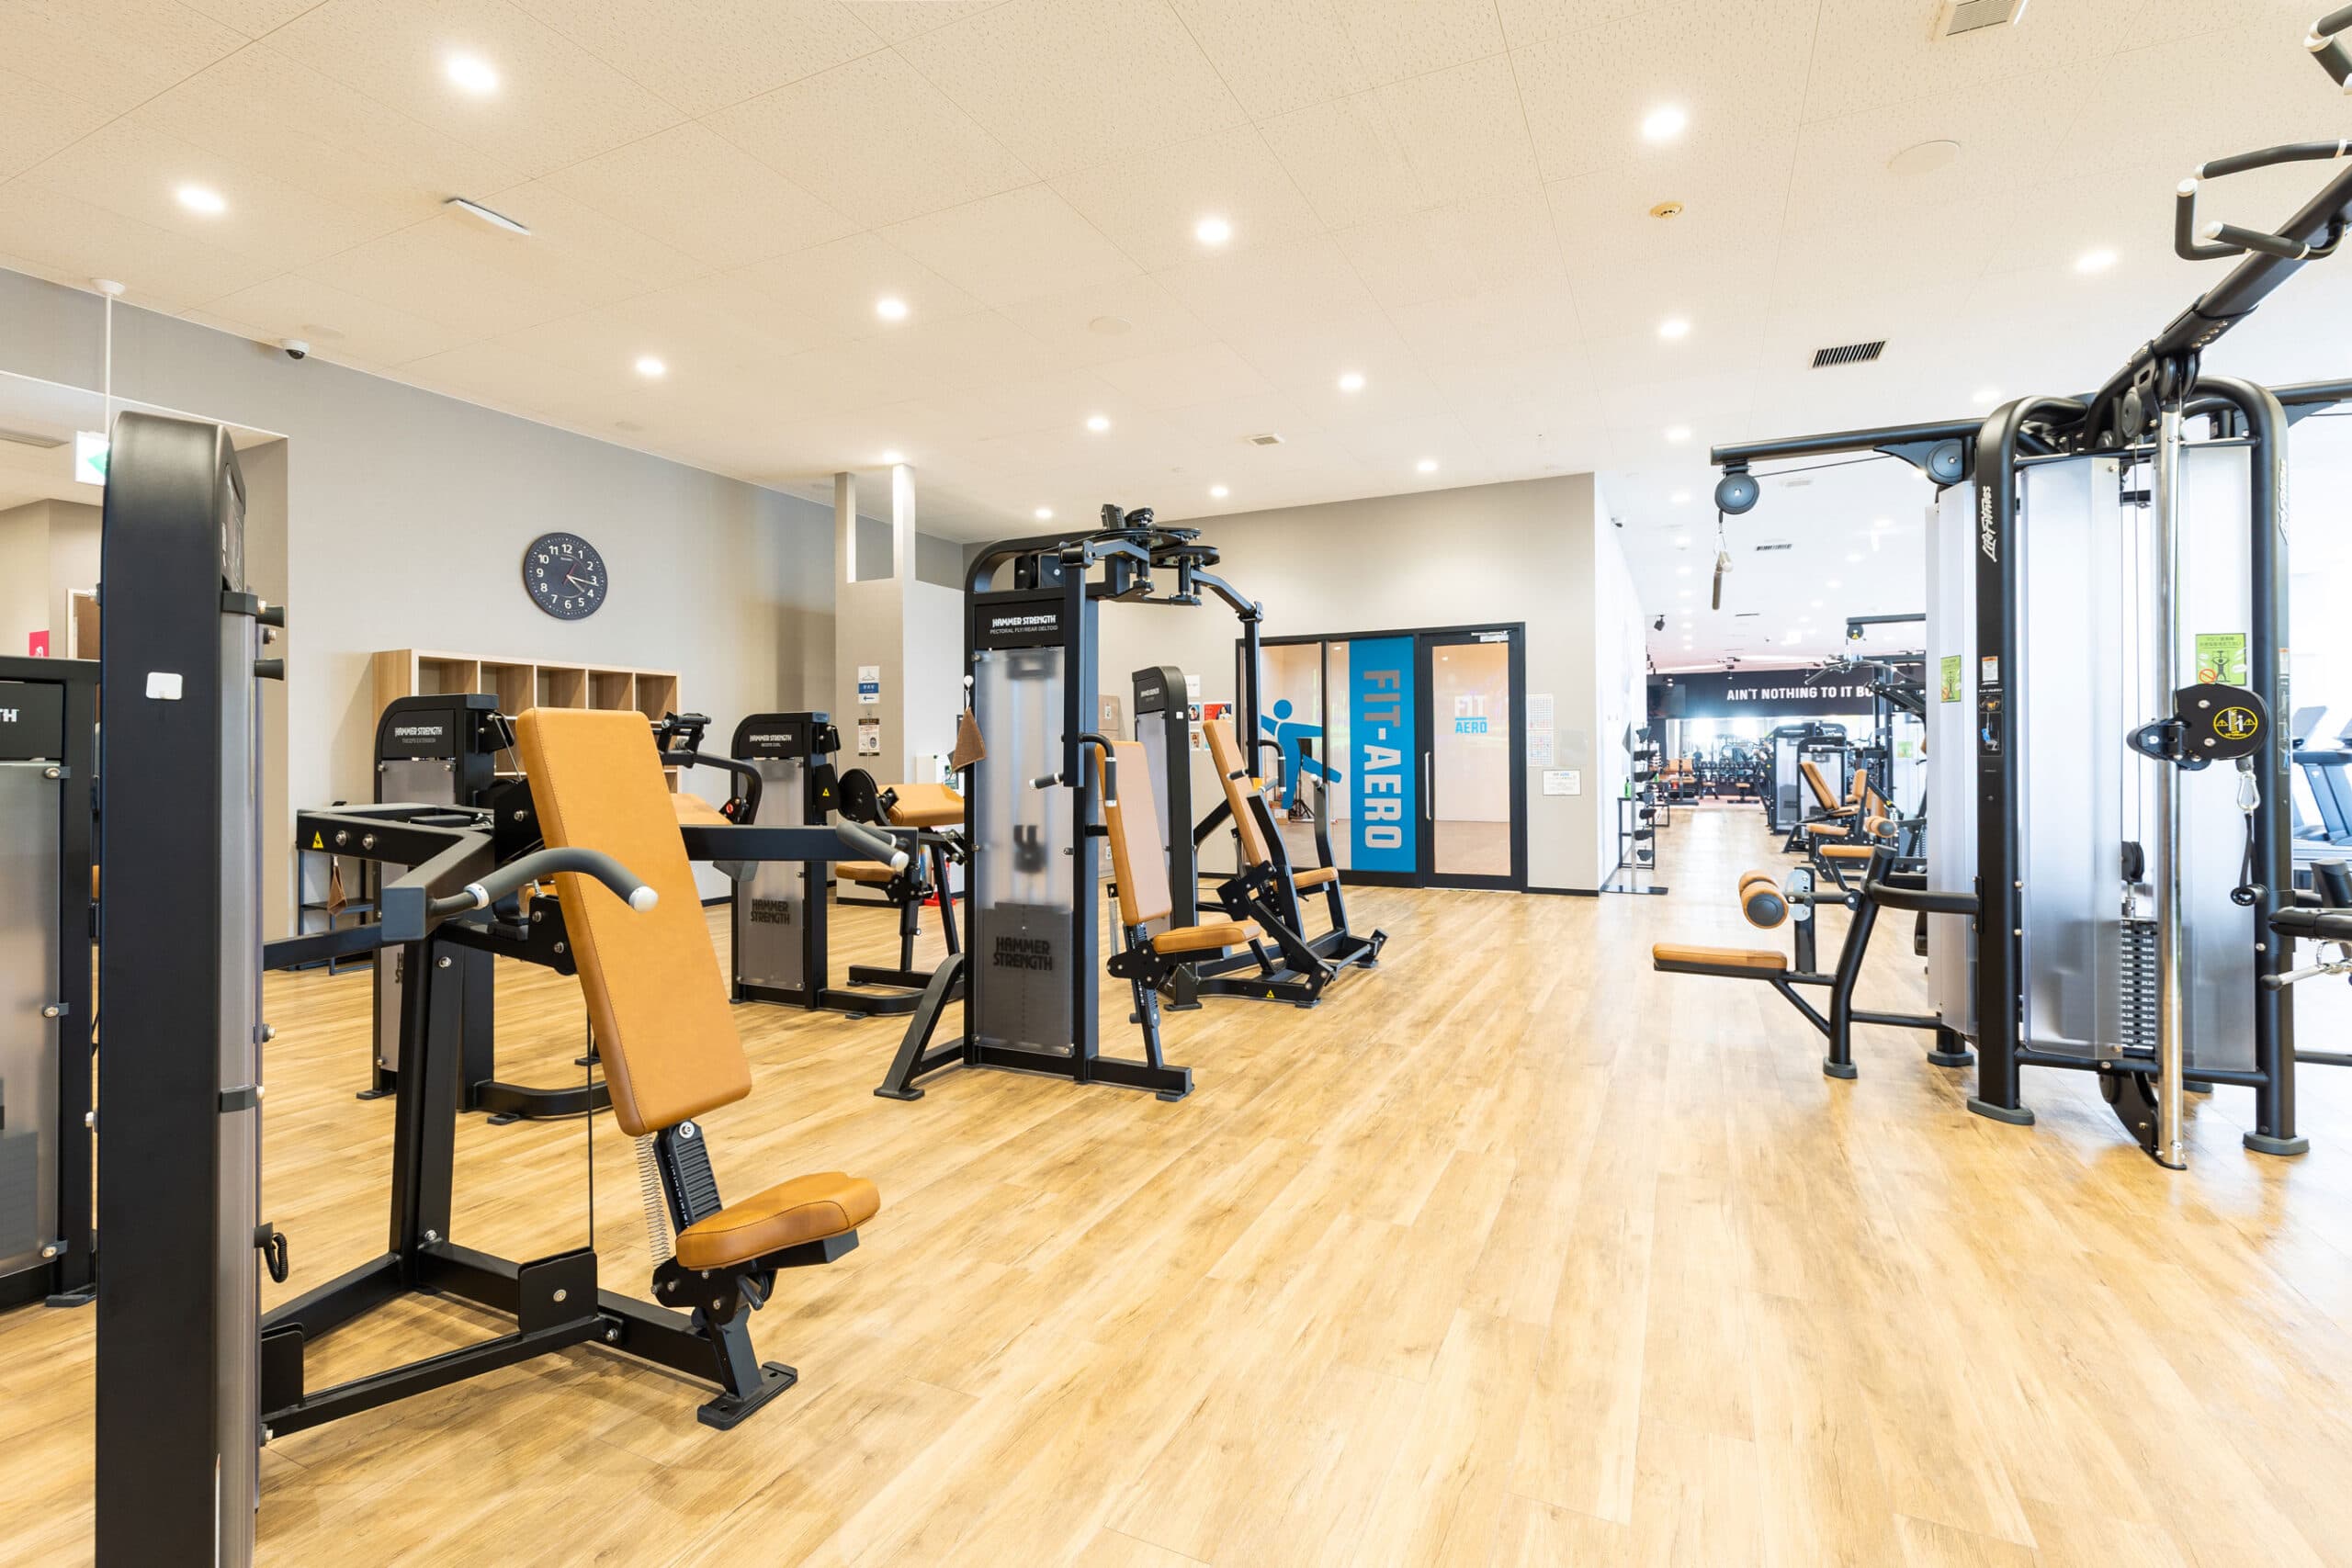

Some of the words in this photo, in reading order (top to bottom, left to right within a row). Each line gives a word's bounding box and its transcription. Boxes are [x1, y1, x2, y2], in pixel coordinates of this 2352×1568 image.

[548, 545, 559, 555] 11
[561, 544, 572, 554] 12
[537, 554, 549, 564] 10
[578, 550, 583, 559] 1
[587, 561, 594, 571] 2
[536, 568, 544, 578] 9
[591, 575, 597, 585] 3
[540, 582, 548, 592] 8
[551, 593, 558, 604] 7
[587, 589, 594, 598] 4
[564, 599, 571, 609] 6
[578, 597, 585, 607] 5
[992, 616, 1022, 628] HAMMER
[1022, 615, 1057, 626] STRENGTH
[1726, 688, 1758, 701] AIN'T
[1761, 686, 1817, 700] NOTHING
[1820, 686, 1837, 698] TO
[1840, 685, 1853, 698] IT
[1454, 695, 1486, 717] FIT
[1454, 721, 1487, 734] AERO
[1363, 670, 1402, 849] FIT-AERO
[752, 898, 788, 912] HAMMER
[750, 910, 790, 924] STRENGTH
[996, 936, 1050, 955] HAMMER
[993, 952, 1053, 971] STRENGTH
